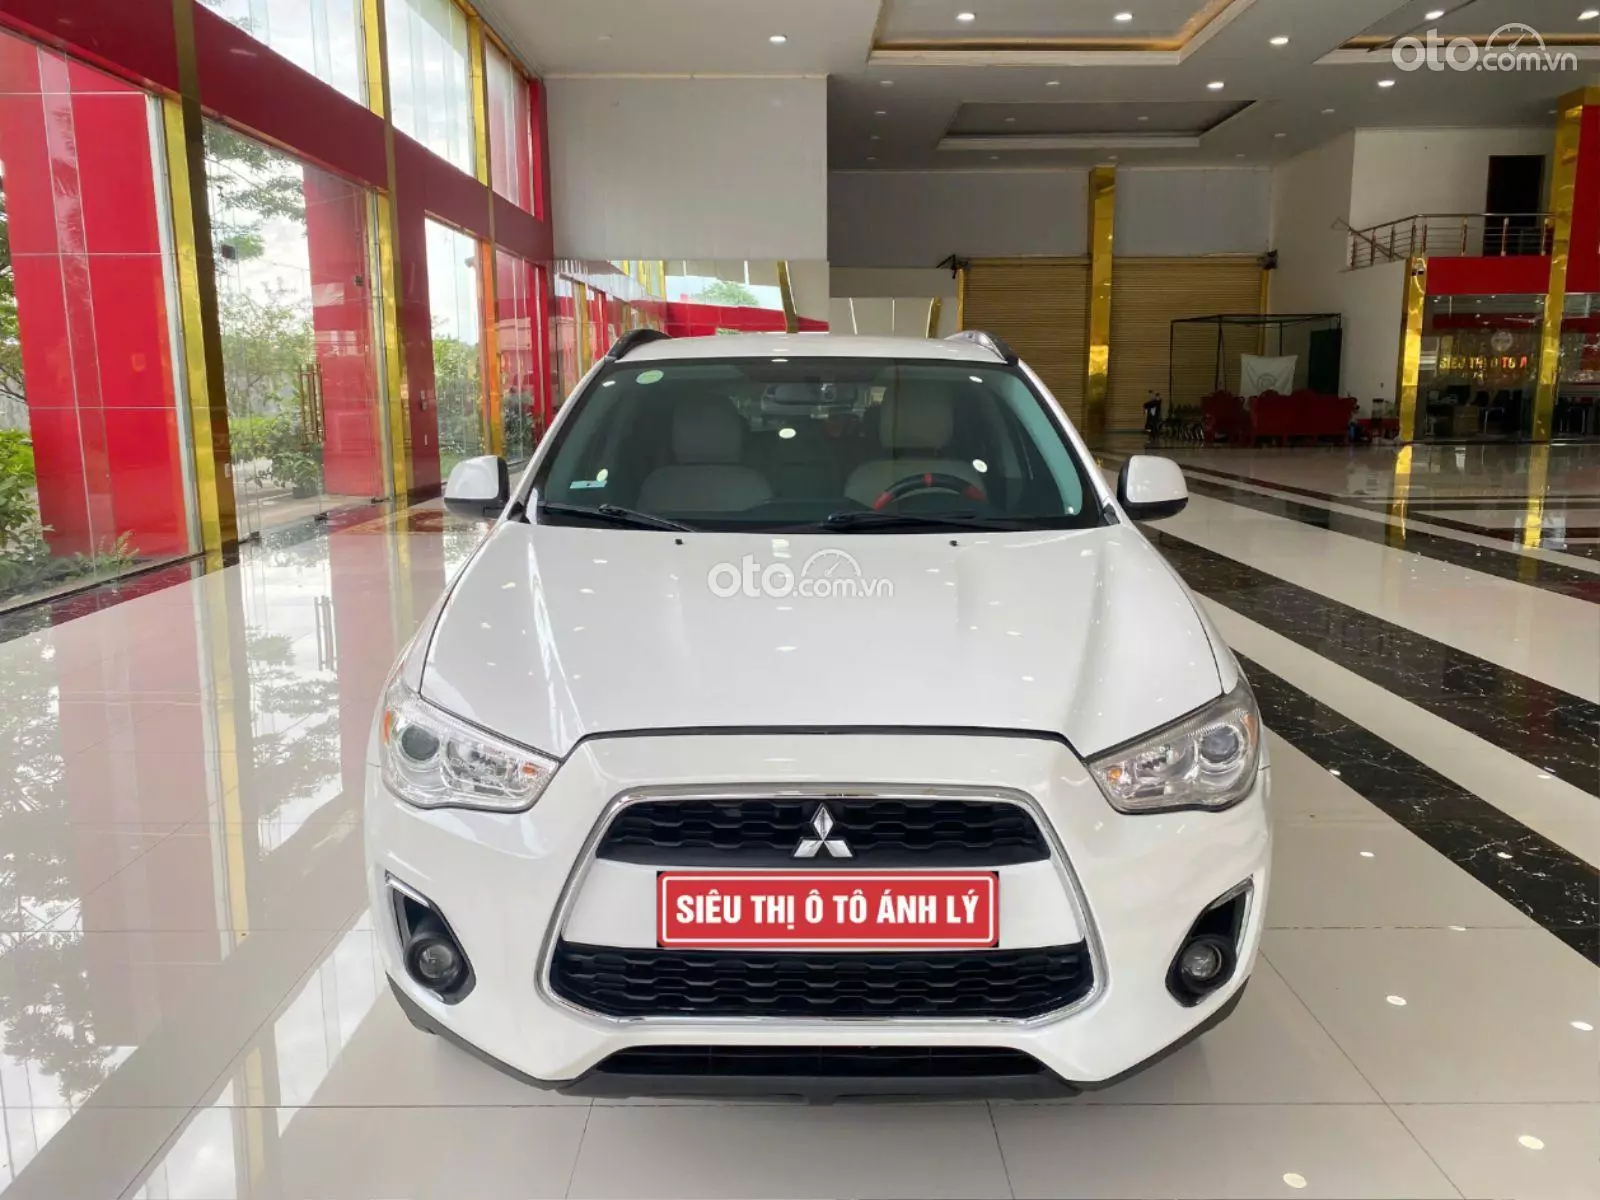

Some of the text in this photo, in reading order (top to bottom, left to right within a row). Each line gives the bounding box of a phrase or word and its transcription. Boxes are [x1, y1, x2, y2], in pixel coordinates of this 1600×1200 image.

[676, 889, 979, 930] SIÊU THỊ Ô TÔ ÁNH LÝ
